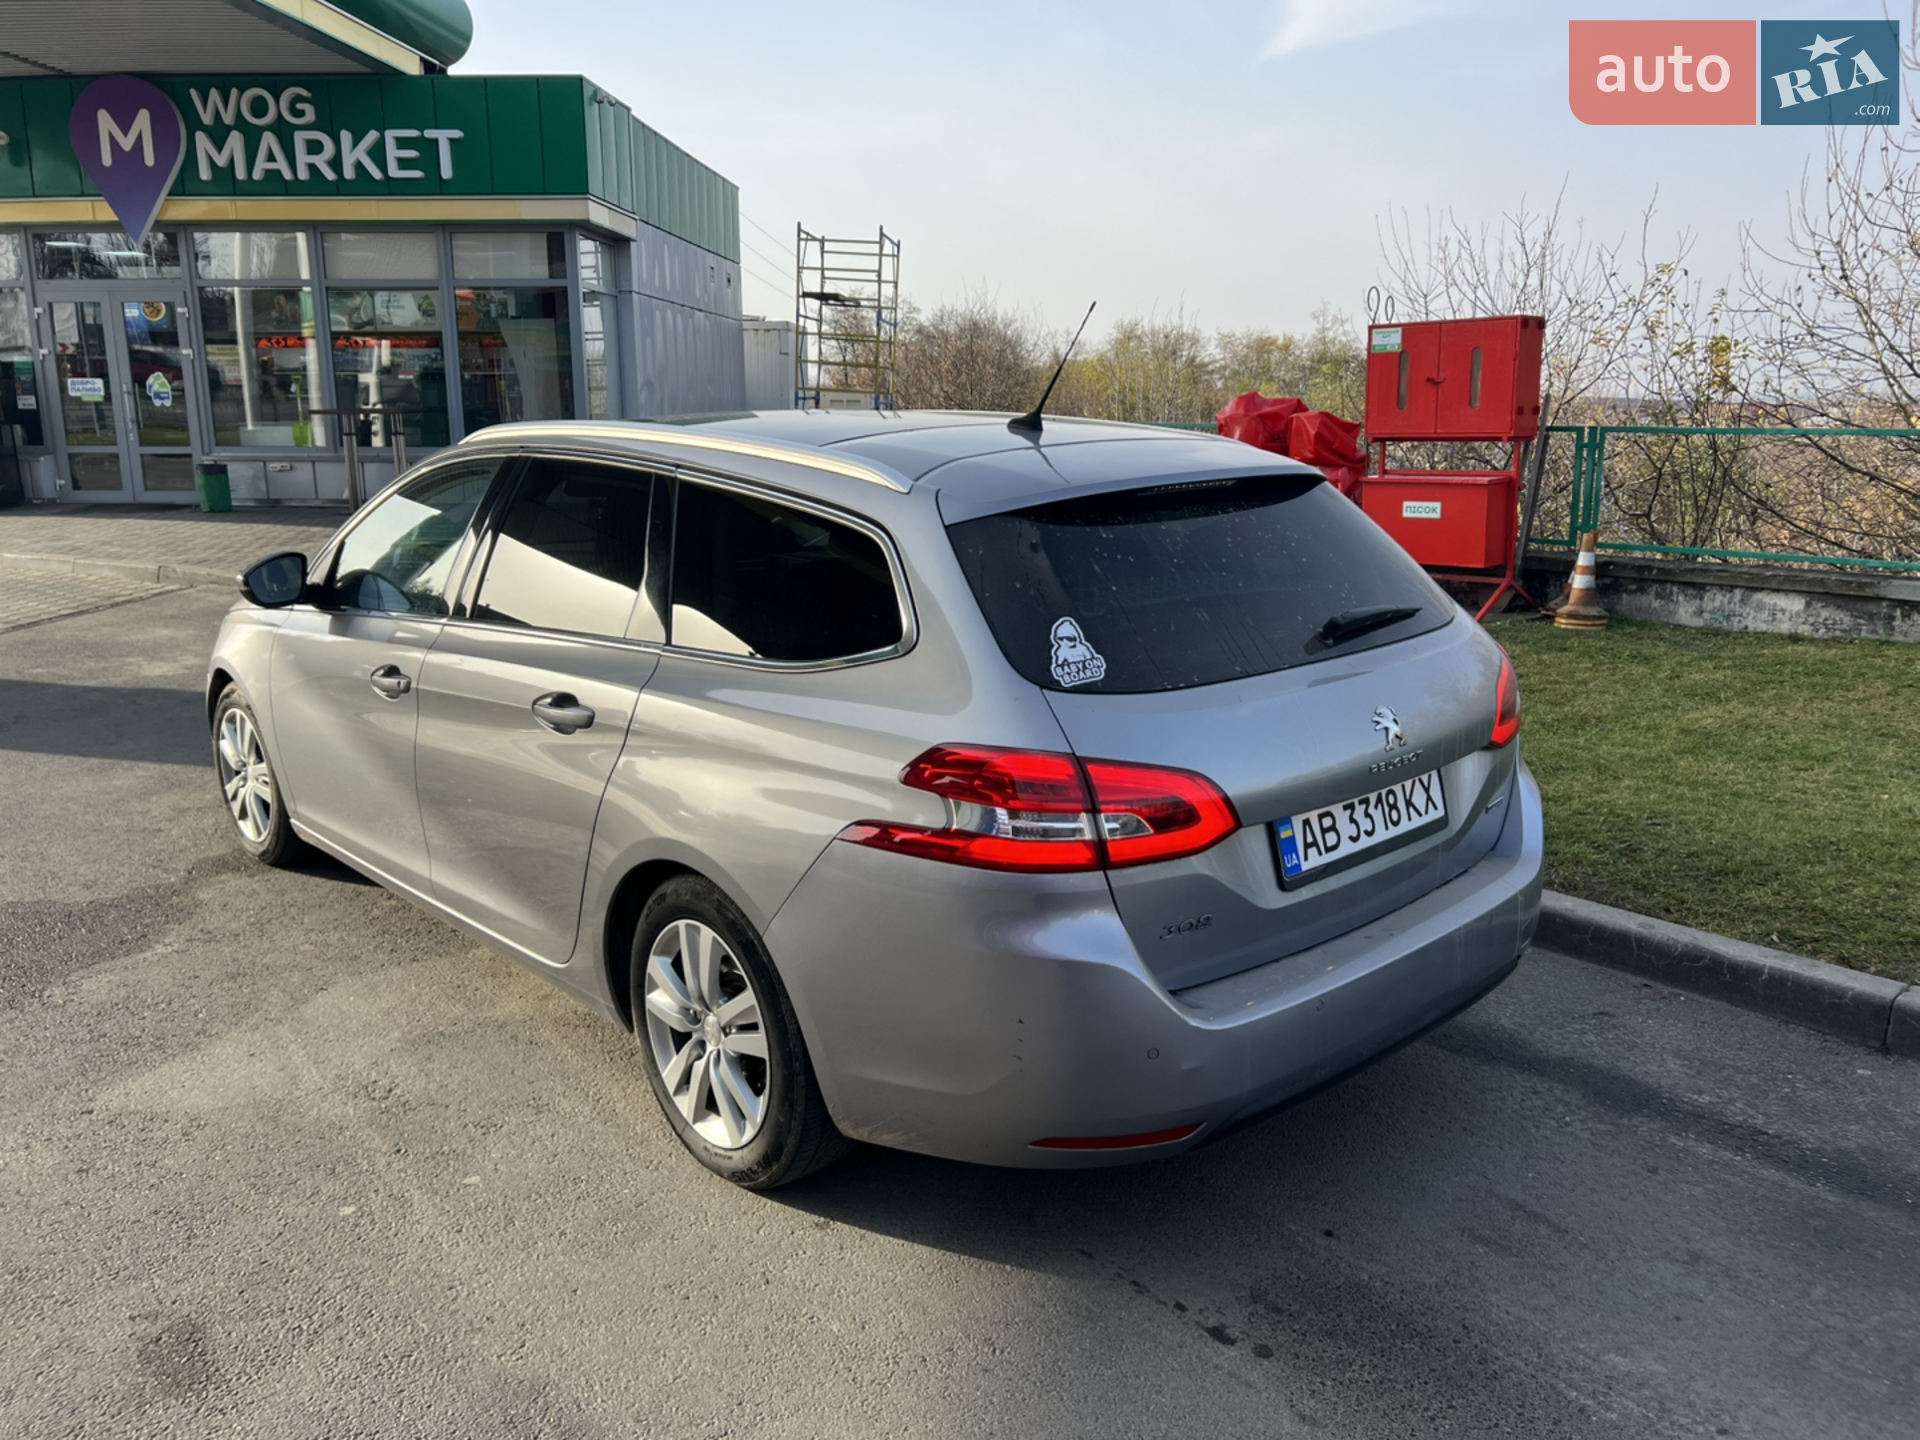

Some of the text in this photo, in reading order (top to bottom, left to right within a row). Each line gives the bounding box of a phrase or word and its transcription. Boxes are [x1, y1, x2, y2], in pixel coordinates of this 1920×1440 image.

[189, 86, 317, 127] WOG
[96, 107, 156, 168] M
[194, 128, 466, 182] MARKET
[1055, 658, 1103, 676] BABY ON
[1062, 669, 1101, 684] BOARD
[1369, 750, 1423, 774] PEUGEOT
[1284, 852, 1300, 868] UA
[1159, 913, 1214, 940] 308
